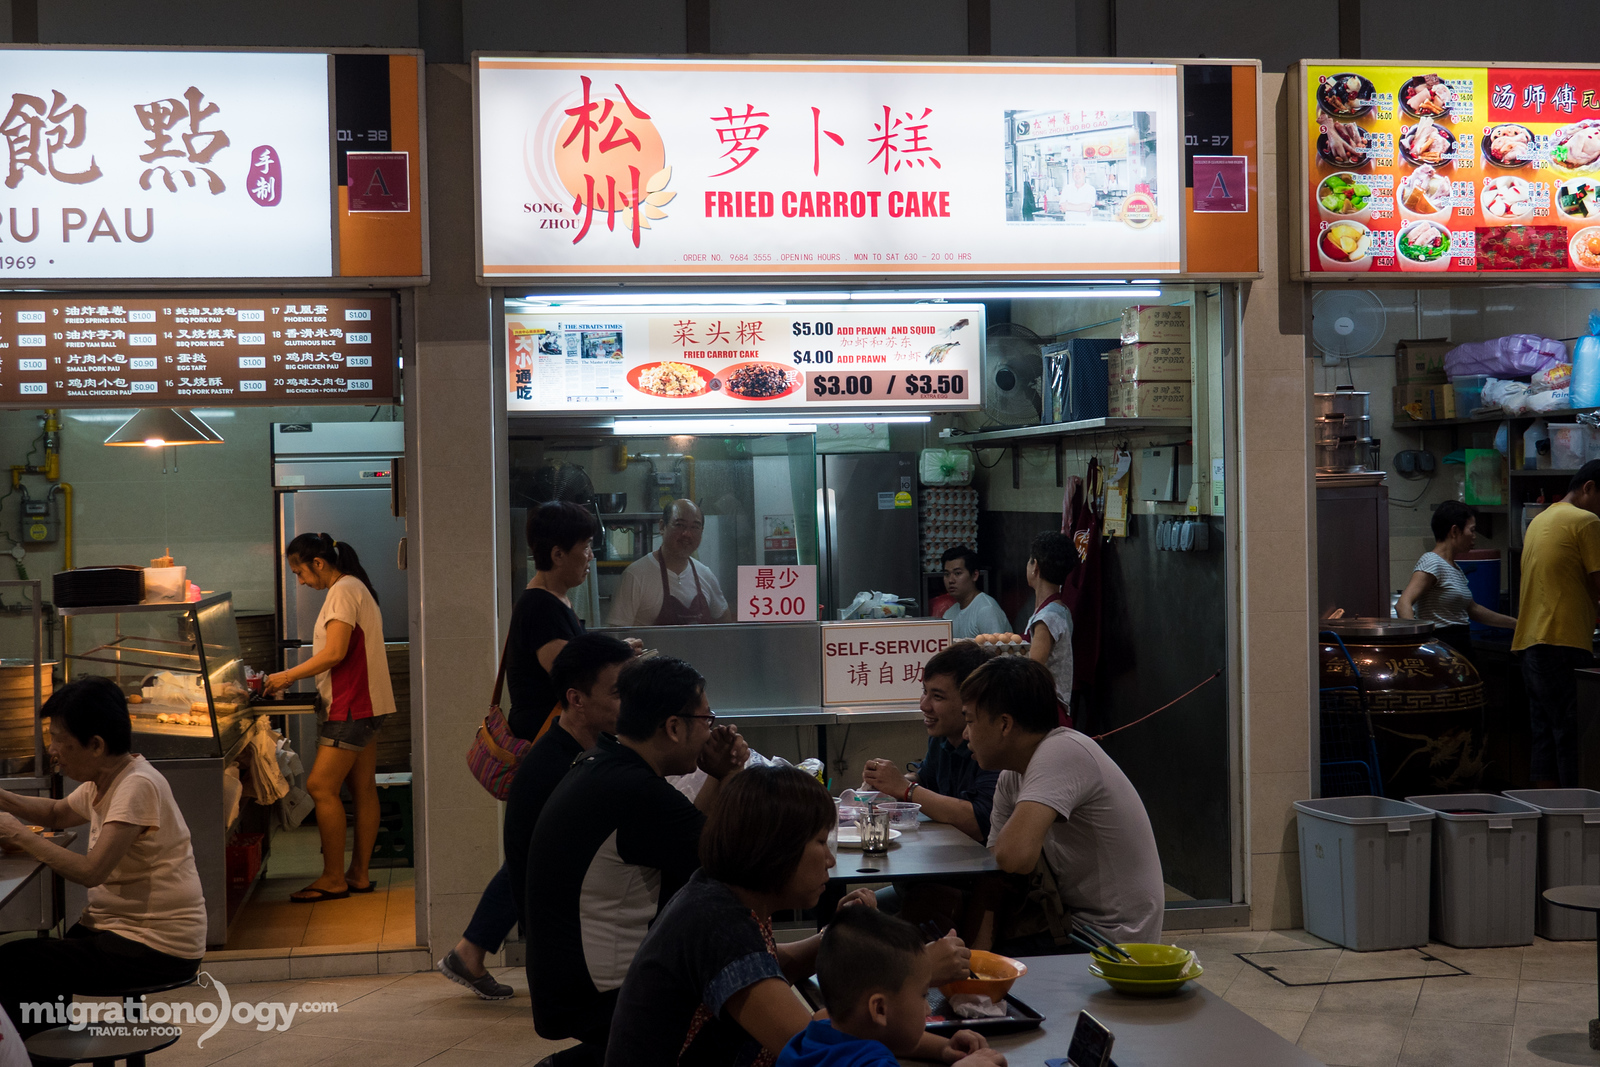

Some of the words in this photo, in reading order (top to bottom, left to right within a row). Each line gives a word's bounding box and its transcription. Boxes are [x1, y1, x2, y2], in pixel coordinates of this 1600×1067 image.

[1492, 83, 1578, 114] 汤师傅
[0, 86, 231, 196] 飽點
[337, 130, 353, 141] 01
[368, 130, 388, 141] 38
[707, 104, 942, 178] 萝卜糕
[1184, 135, 1198, 146] 01
[1212, 135, 1229, 146] 37
[562, 75, 652, 249] 松州
[250, 148, 278, 203] 手制
[363, 167, 393, 196] A
[1206, 171, 1232, 198] A
[523, 202, 563, 214] SONG
[704, 190, 774, 218] FRIED
[781, 190, 882, 218] CARROT
[888, 190, 950, 218] CAKE
[0, 207, 40, 243] U
[62, 207, 154, 244] PAU
[539, 218, 580, 230] ZHOU
[683, 254, 708, 262] ORDER
[711, 254, 723, 262] NO.
[730, 254, 749, 262] 9684
[753, 254, 772, 262] 3555
[817, 254, 840, 262] HOURS
[854, 253, 868, 261] MON
[873, 253, 882, 261] TO
[886, 253, 900, 261] SAT
[904, 253, 918, 261] 630
[931, 253, 941, 261] 20
[945, 253, 954, 261] 00
[958, 253, 972, 261] HRS
[65, 306, 127, 316] 油炸春卷
[66, 330, 126, 340] 油炸芋角
[671, 319, 766, 348] 菜头粿
[792, 322, 834, 336] $5.00
[837, 327, 854, 335] ADD
[856, 326, 887, 335] PRAWN
[891, 326, 908, 334] AND
[910, 326, 936, 335] SQUID
[840, 336, 912, 348] 加虾和苏东
[286, 352, 344, 362] 鸡肉大包
[793, 350, 833, 364] $4.00
[856, 355, 886, 363] PRAWN
[893, 351, 922, 362] 加虾
[515, 336, 533, 400] 大小通吃
[68, 378, 128, 388] 鸡肉小包
[814, 374, 872, 396] $3.00
[886, 375, 896, 394] /
[906, 374, 964, 395] $3.50
[755, 568, 799, 590] 最少
[750, 596, 805, 618] $3.00
[826, 638, 948, 657] SELF-SERVICE
[847, 661, 924, 686] 请自助
